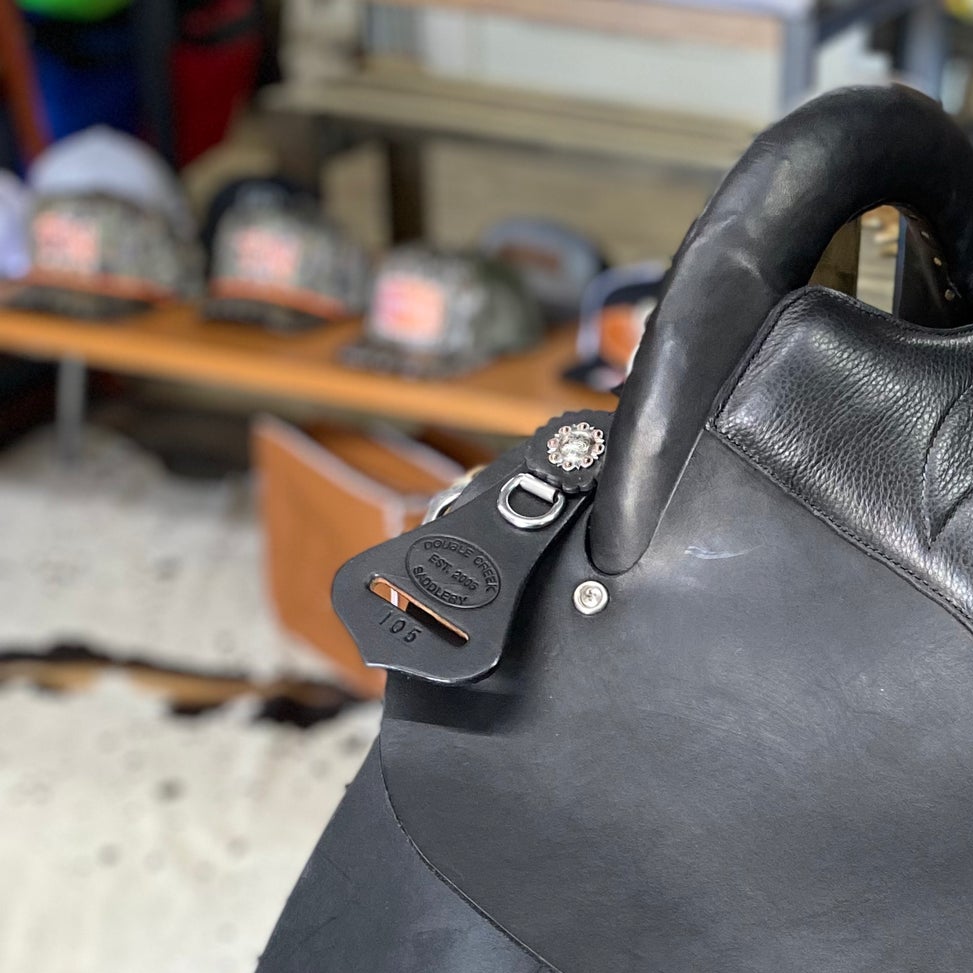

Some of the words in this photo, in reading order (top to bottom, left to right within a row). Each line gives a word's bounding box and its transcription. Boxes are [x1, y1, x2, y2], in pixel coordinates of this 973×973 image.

[423, 539, 475, 558] DOUBLE
[473, 555, 499, 592] CREEK
[428, 553, 453, 574] EST.
[378, 609, 422, 643] 105
